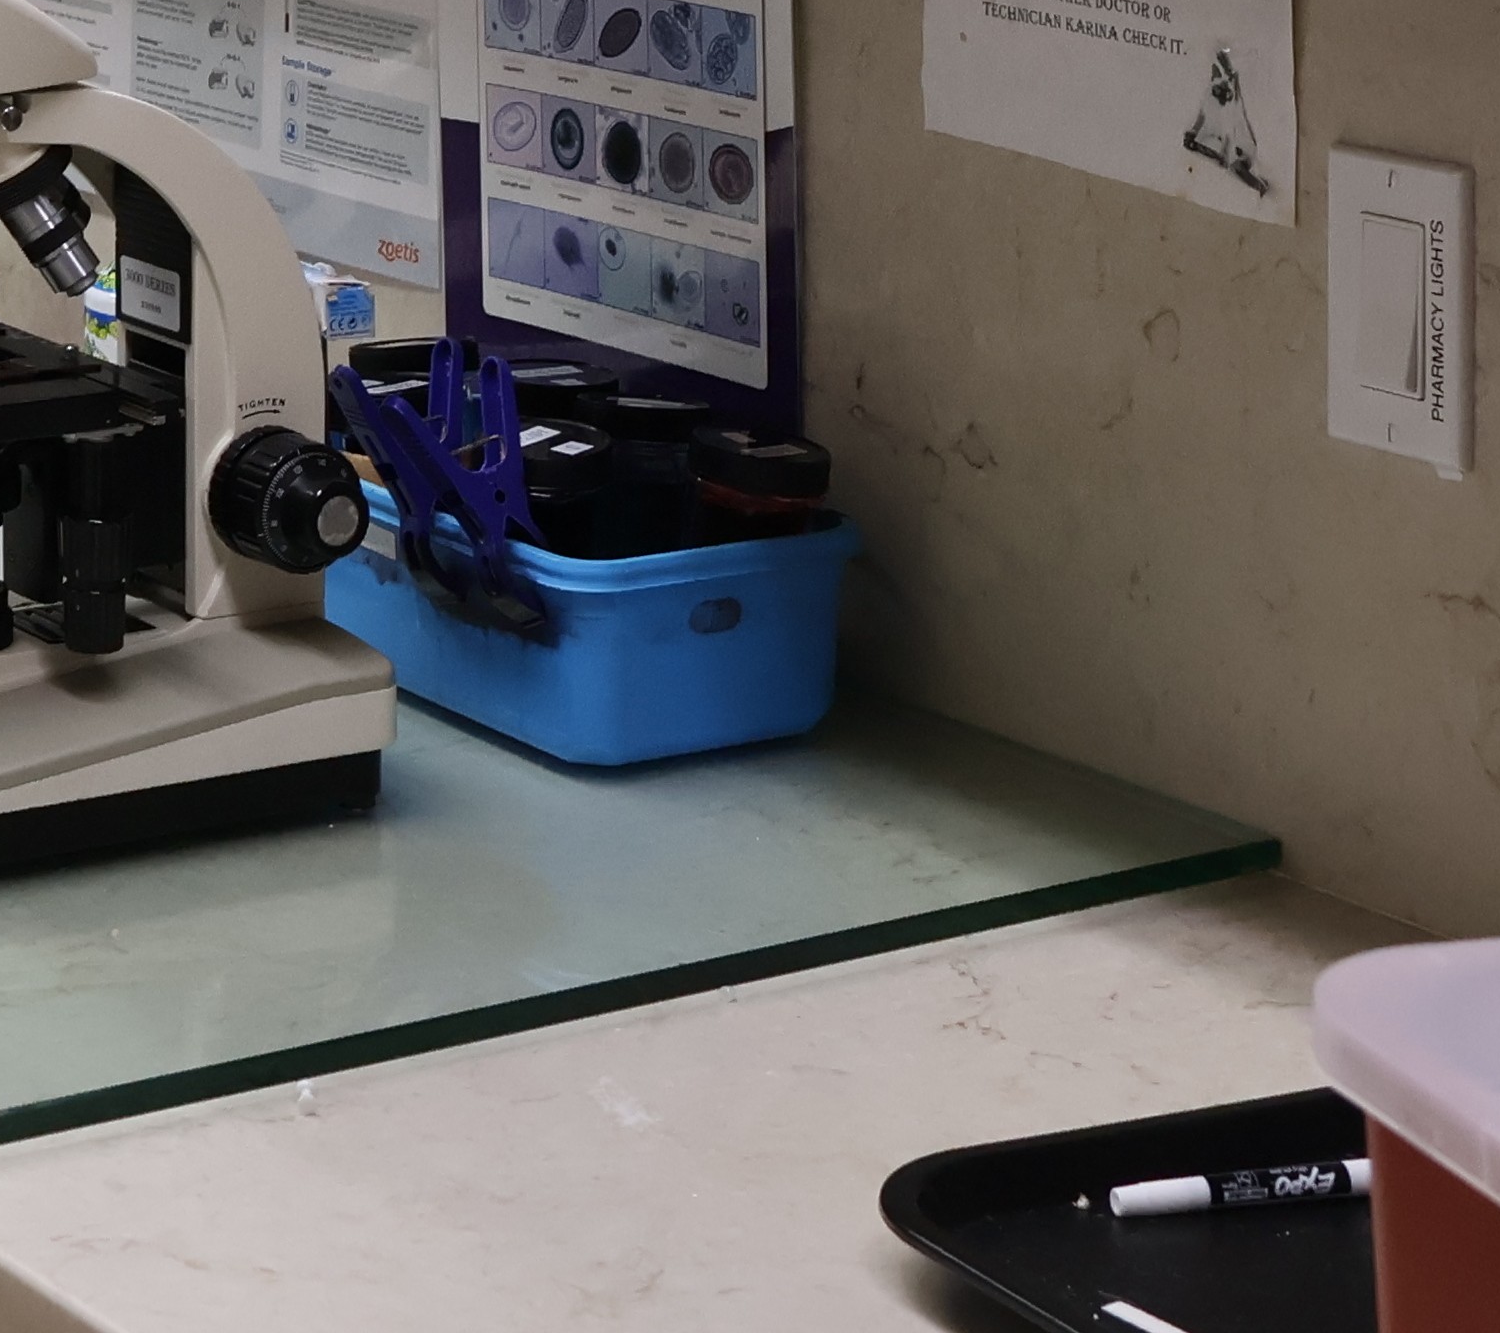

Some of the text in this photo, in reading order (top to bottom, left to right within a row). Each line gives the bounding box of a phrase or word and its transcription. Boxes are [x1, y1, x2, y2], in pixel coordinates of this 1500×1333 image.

[1153, 3, 1172, 24] OR
[981, 0, 1188, 56] TECHNICIAN KARINA CHECK IT.
[281, 55, 332, 77] Sample Storage
[377, 238, 420, 264] zoetis
[144, 272, 177, 298] SERIES
[1429, 218, 1446, 423] PHARMACY LIGHTS
[237, 397, 287, 413] TIGHTEN
[1274, 1165, 1337, 1196] EXPO
